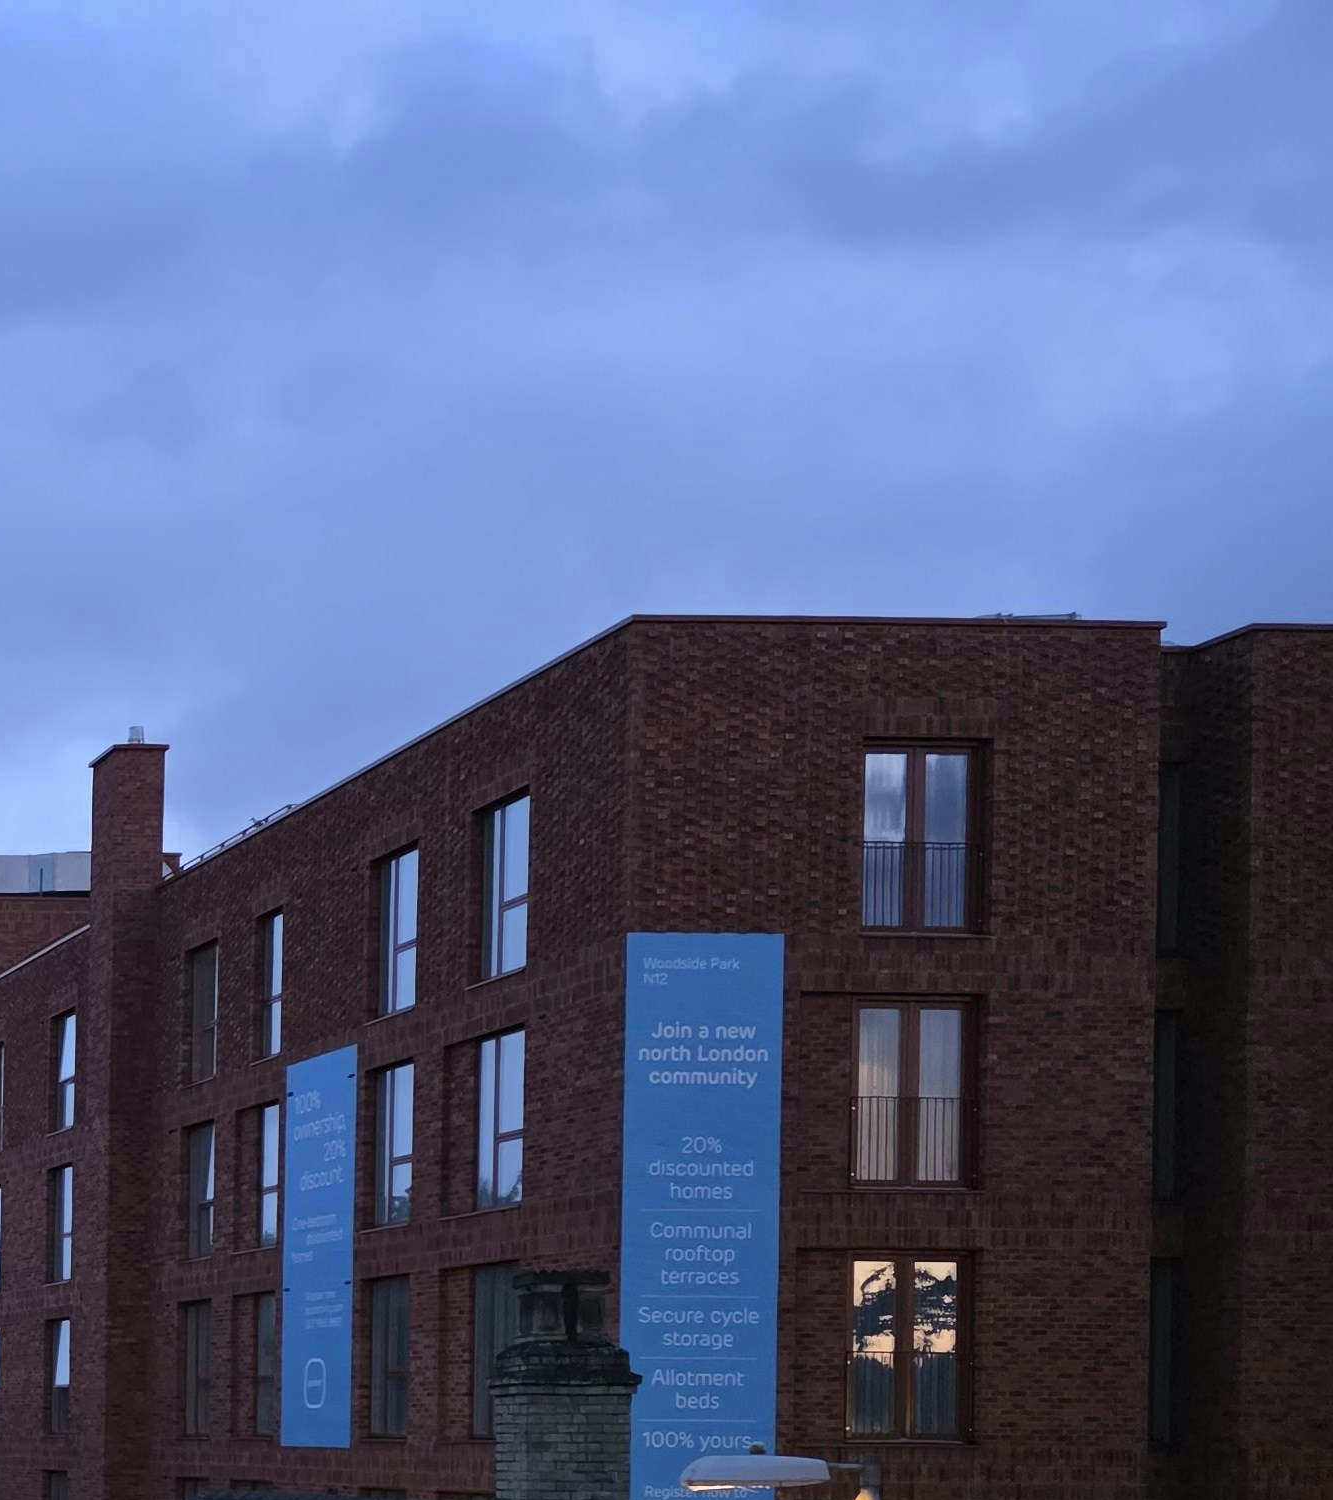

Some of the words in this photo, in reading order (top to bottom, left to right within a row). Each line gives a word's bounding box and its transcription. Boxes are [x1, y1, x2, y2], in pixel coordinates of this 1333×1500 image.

[643, 957, 707, 970] Woodside
[710, 957, 740, 970] Park
[643, 972, 669, 985] N12
[651, 1021, 692, 1039] Join
[699, 1026, 709, 1039] a
[715, 1025, 756, 1039] new
[638, 1044, 692, 1062] north
[697, 1045, 768, 1062] London
[648, 1068, 758, 1089] community
[294, 1090, 321, 1115] 100%
[323, 1139, 346, 1162] 20%
[681, 1136, 723, 1154] 20%
[648, 1159, 754, 1177] discounted
[670, 1182, 733, 1200] homes
[650, 1222, 752, 1240] Communal
[665, 1245, 736, 1266] rooftop
[660, 1269, 740, 1285] terraces
[638, 1307, 704, 1324] Secure
[710, 1307, 760, 1328] cycle
[662, 1331, 734, 1351] storage
[651, 1368, 745, 1387] Allotment
[675, 1391, 720, 1409] beds
[642, 1430, 695, 1449] 100%
